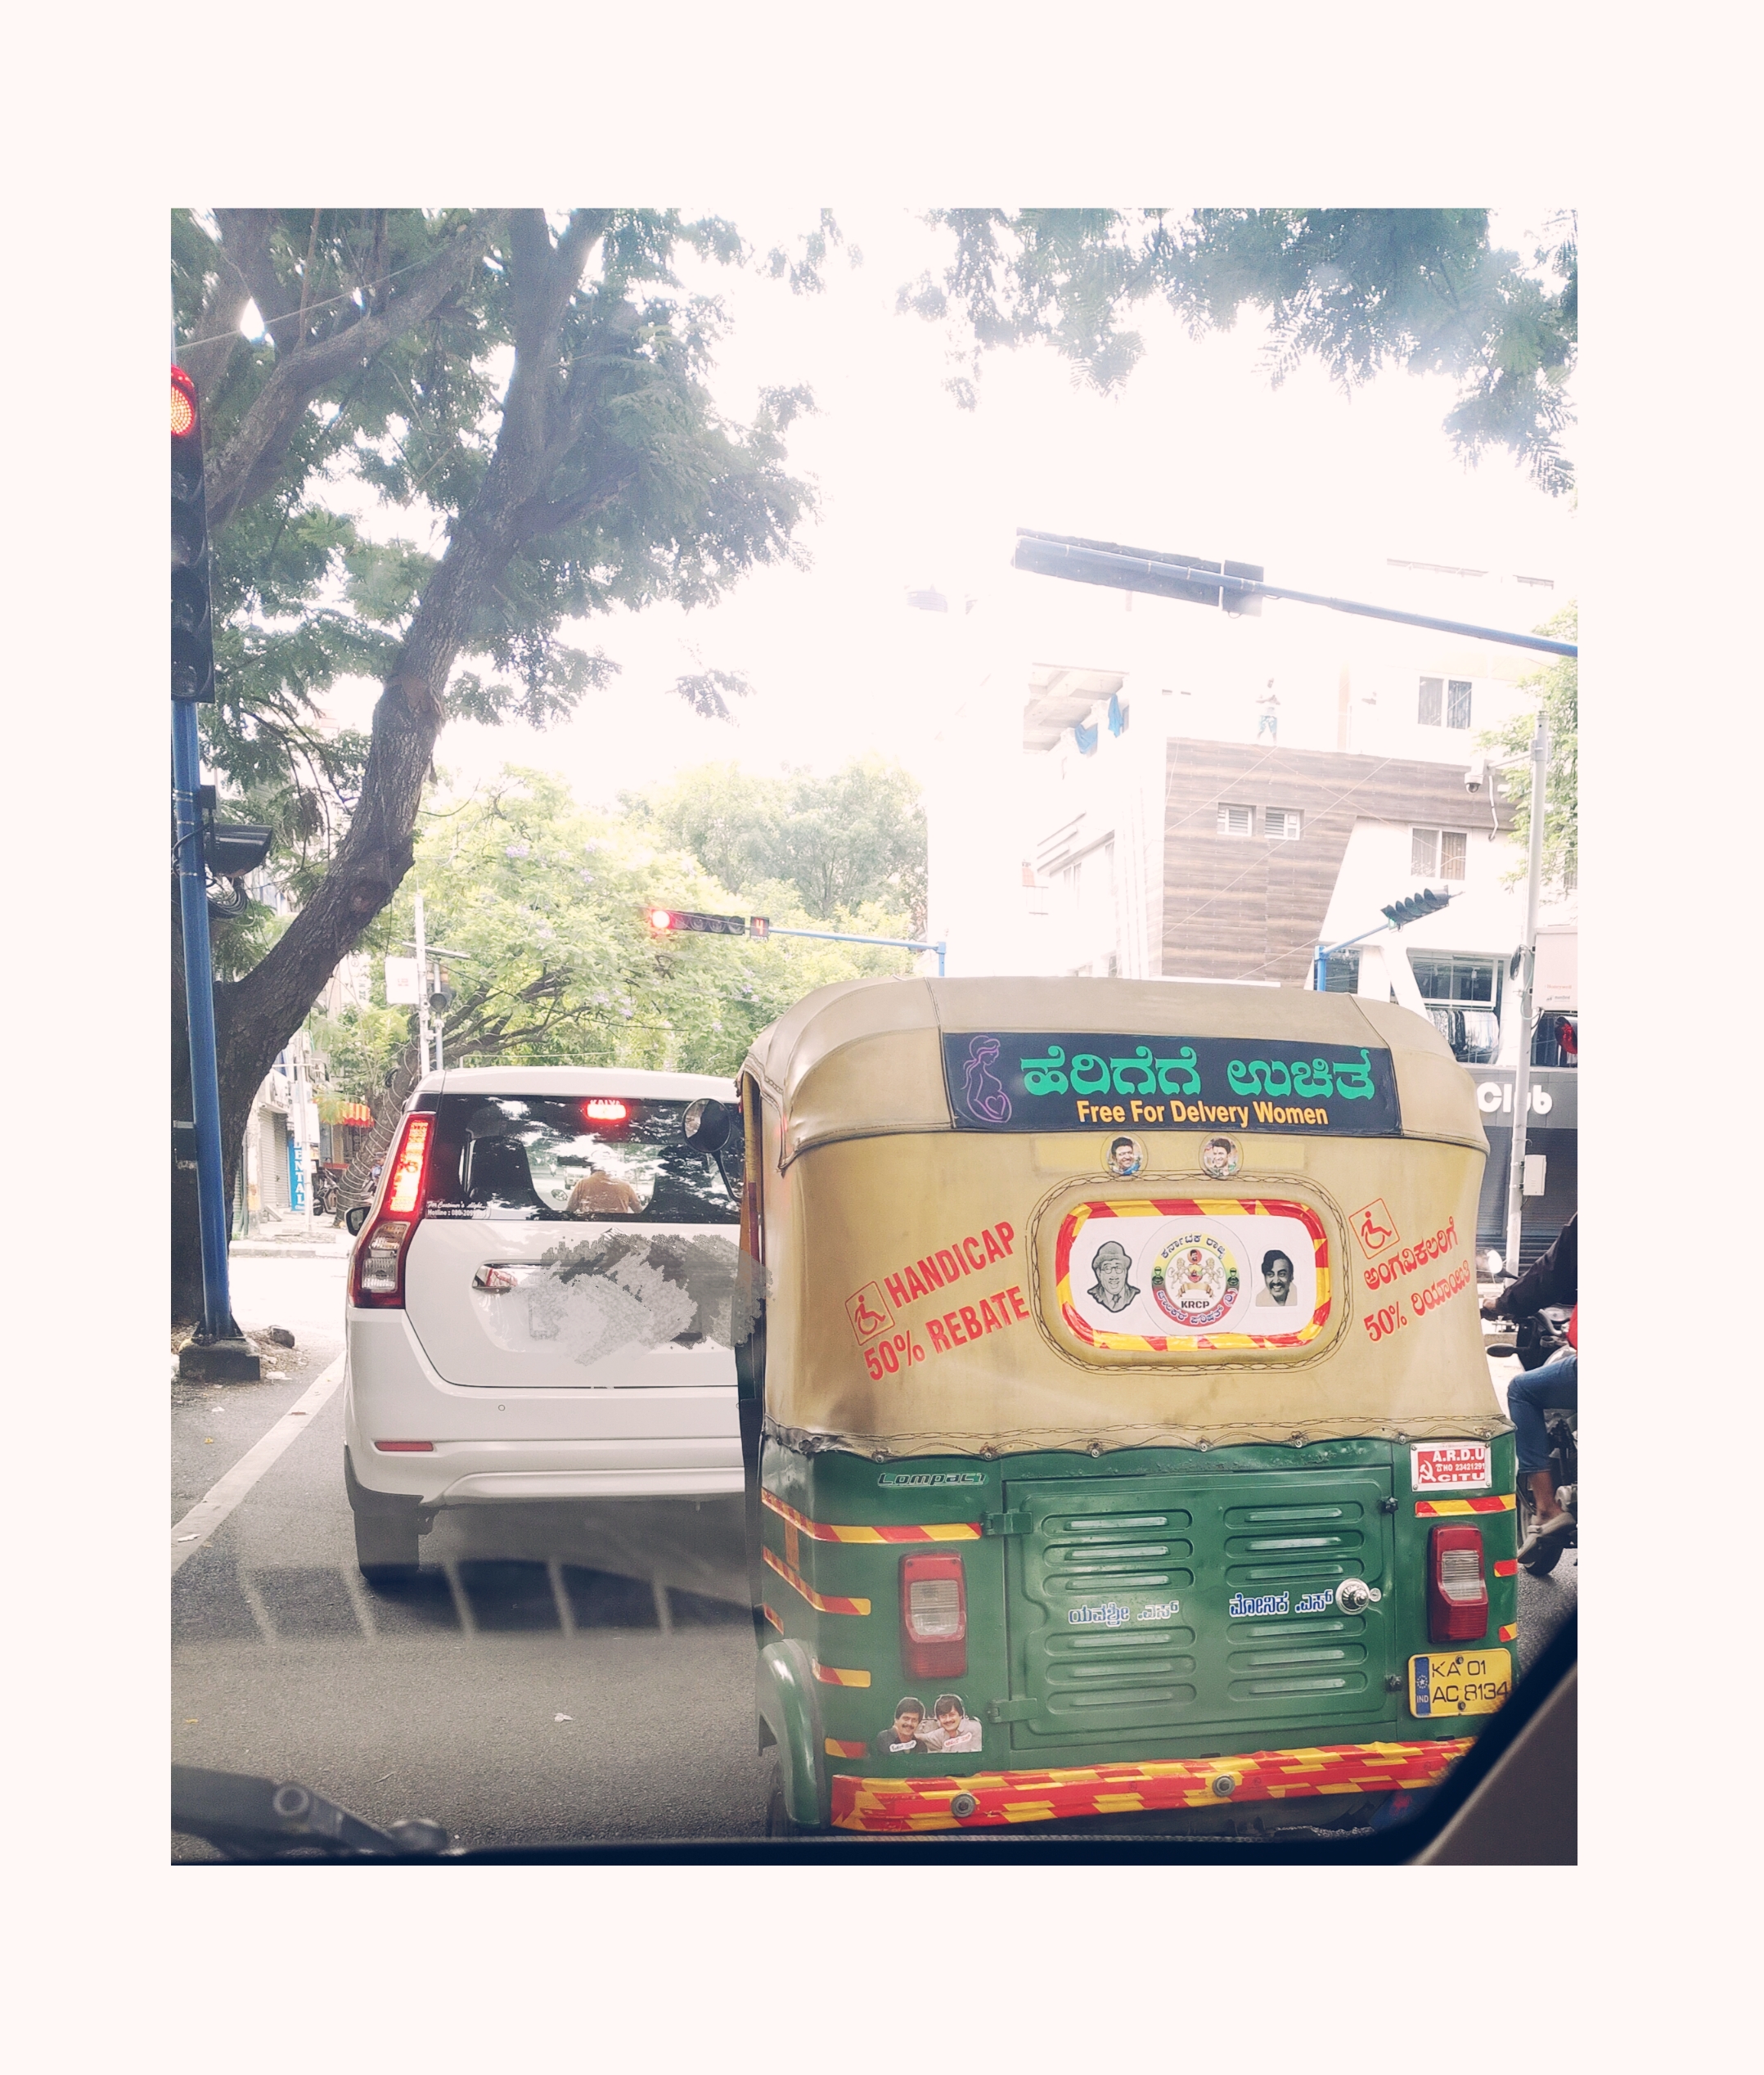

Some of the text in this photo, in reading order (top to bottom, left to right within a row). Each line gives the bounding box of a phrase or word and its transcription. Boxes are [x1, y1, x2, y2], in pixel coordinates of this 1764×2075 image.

[1020, 1045, 1375, 1100] ಹೆರಿಗೆಗೆ ಉಚಿತ
[1077, 1100, 1328, 1128] Free For Delvery Women
[884, 1222, 1015, 1308] HANDICAP
[1364, 1216, 1458, 1290] ಅಂಗವಿಕಲರಿಗೆ
[1181, 1300, 1209, 1308] KRCP
[864, 1285, 1031, 1380] 50% REBATE
[1364, 1301, 1407, 1341] 50%
[1438, 1473, 1484, 1482] CITU
[1455, 1463, 1485, 1471] 23421291
[1230, 1591, 1289, 1617] ಮೋನಿಕ
[1432, 1660, 1486, 1677] KA 01
[1433, 1681, 1508, 1703] AC 8134
